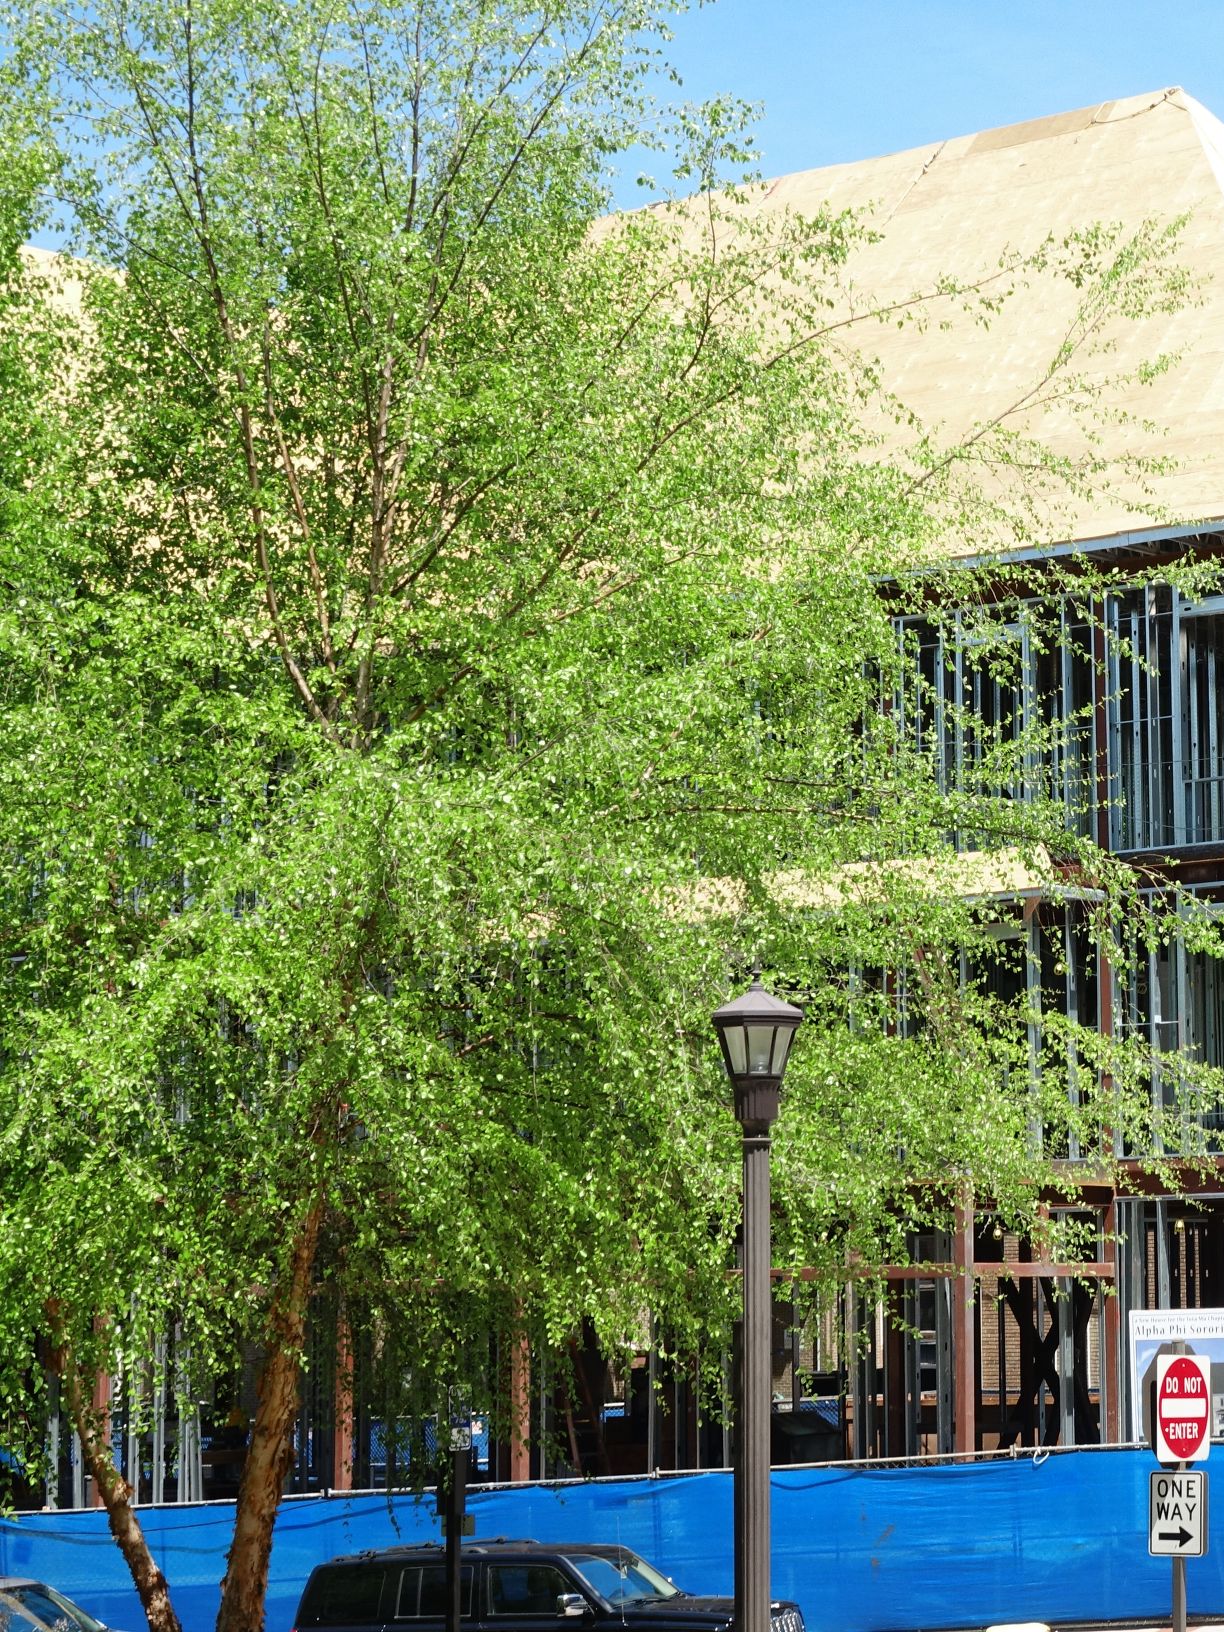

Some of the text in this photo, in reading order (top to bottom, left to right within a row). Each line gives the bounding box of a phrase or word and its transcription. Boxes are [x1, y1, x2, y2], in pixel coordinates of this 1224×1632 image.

[1135, 1325, 1165, 1338] Alpha
[1169, 1324, 1186, 1335] Phi
[1166, 1377, 1202, 1393] DO NOT
[1169, 1422, 1199, 1440] ENTER
[1157, 1479, 1196, 1499] ONE
[1157, 1502, 1197, 1521] WAY
